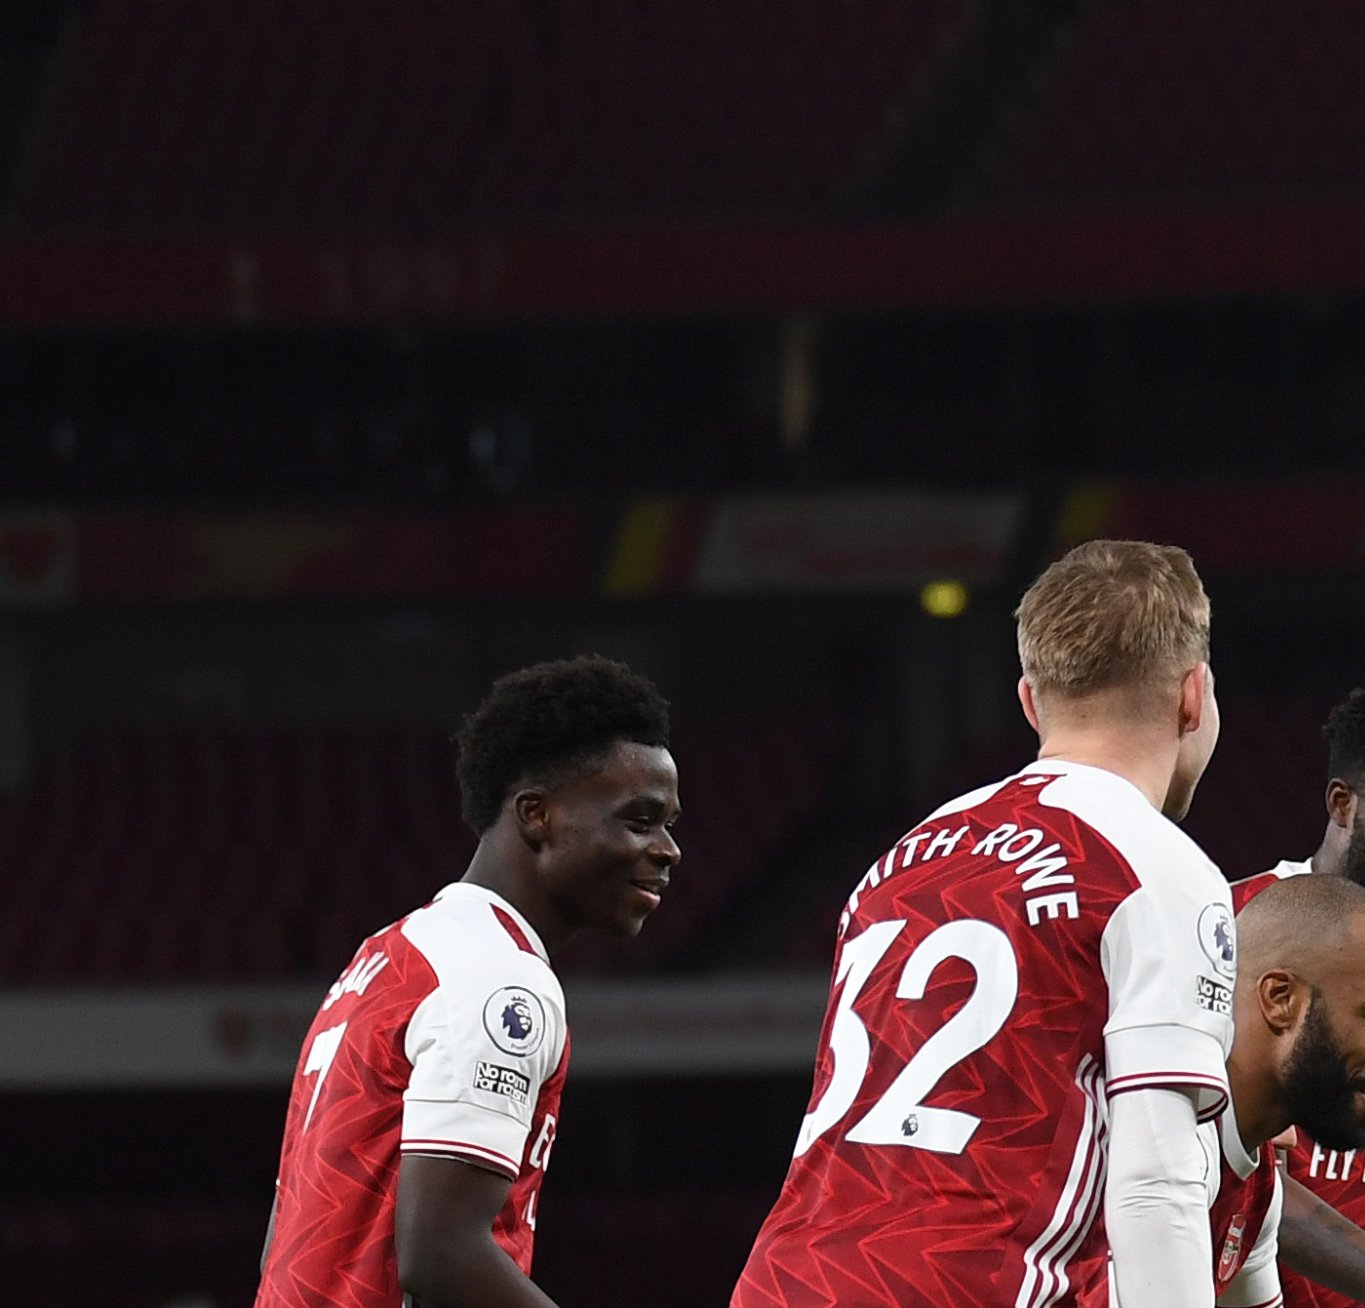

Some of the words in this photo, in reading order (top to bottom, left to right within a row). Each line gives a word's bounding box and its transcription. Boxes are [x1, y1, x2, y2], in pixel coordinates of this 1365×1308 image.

[971, 823, 1079, 927] ROWE
[303, 1021, 348, 1136] 7
[793, 919, 1020, 1158] 32
[1309, 1143, 1357, 1181] FLY
